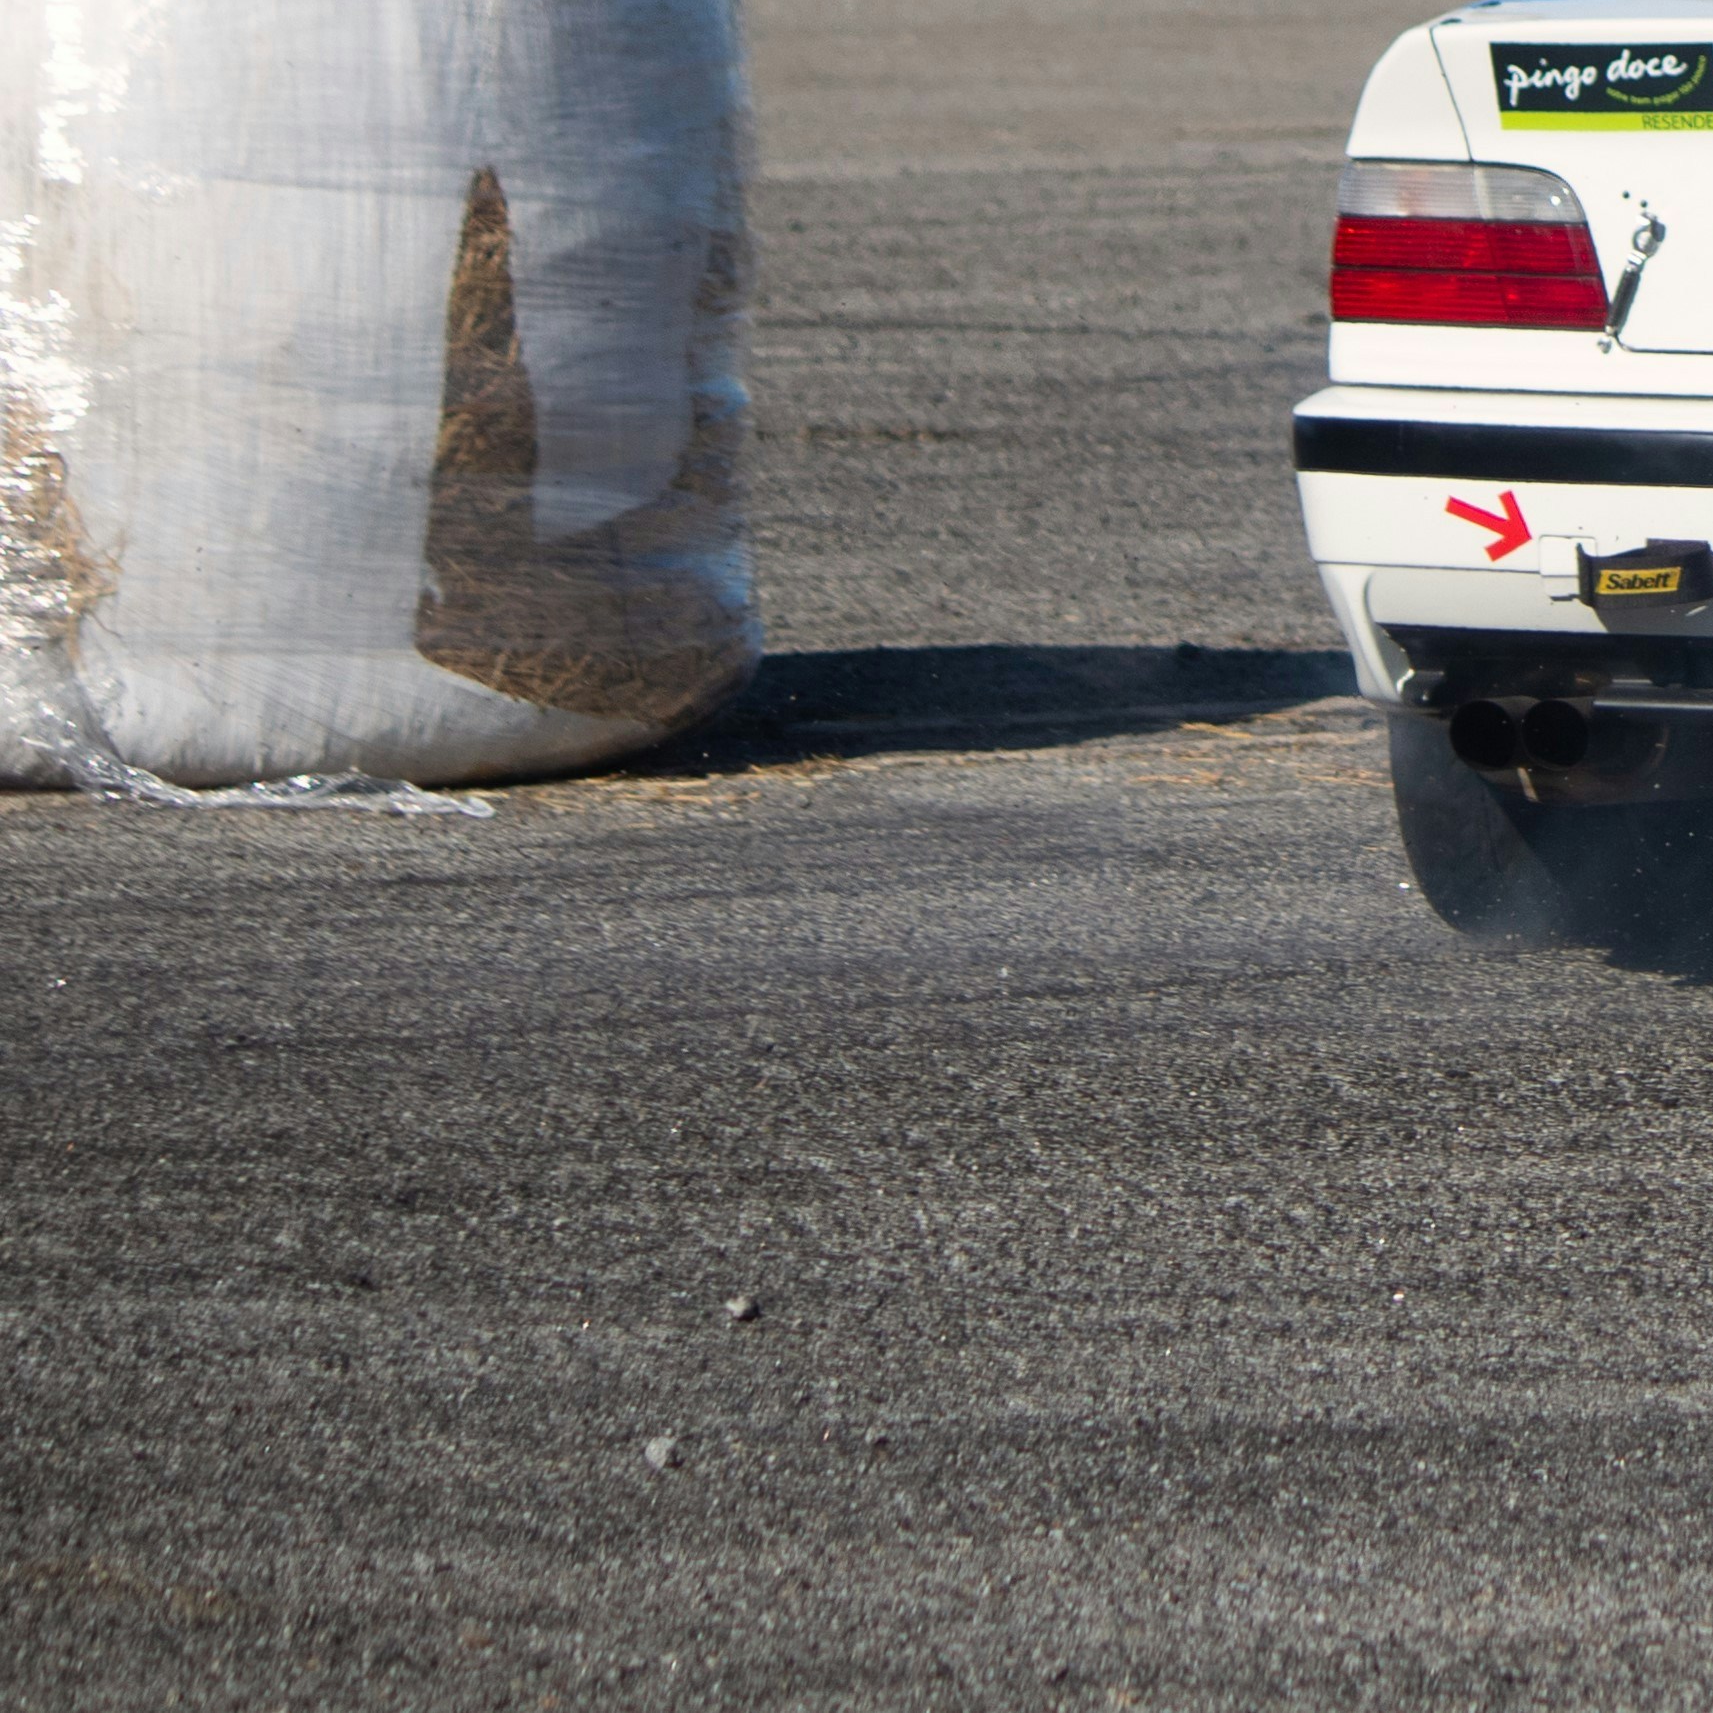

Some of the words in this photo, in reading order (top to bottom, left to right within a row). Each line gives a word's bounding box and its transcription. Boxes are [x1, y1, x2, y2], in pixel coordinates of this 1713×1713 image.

[1503, 58, 1598, 106] pingo
[1606, 48, 1689, 82] doce
[1606, 572, 1670, 590] Sabelt
